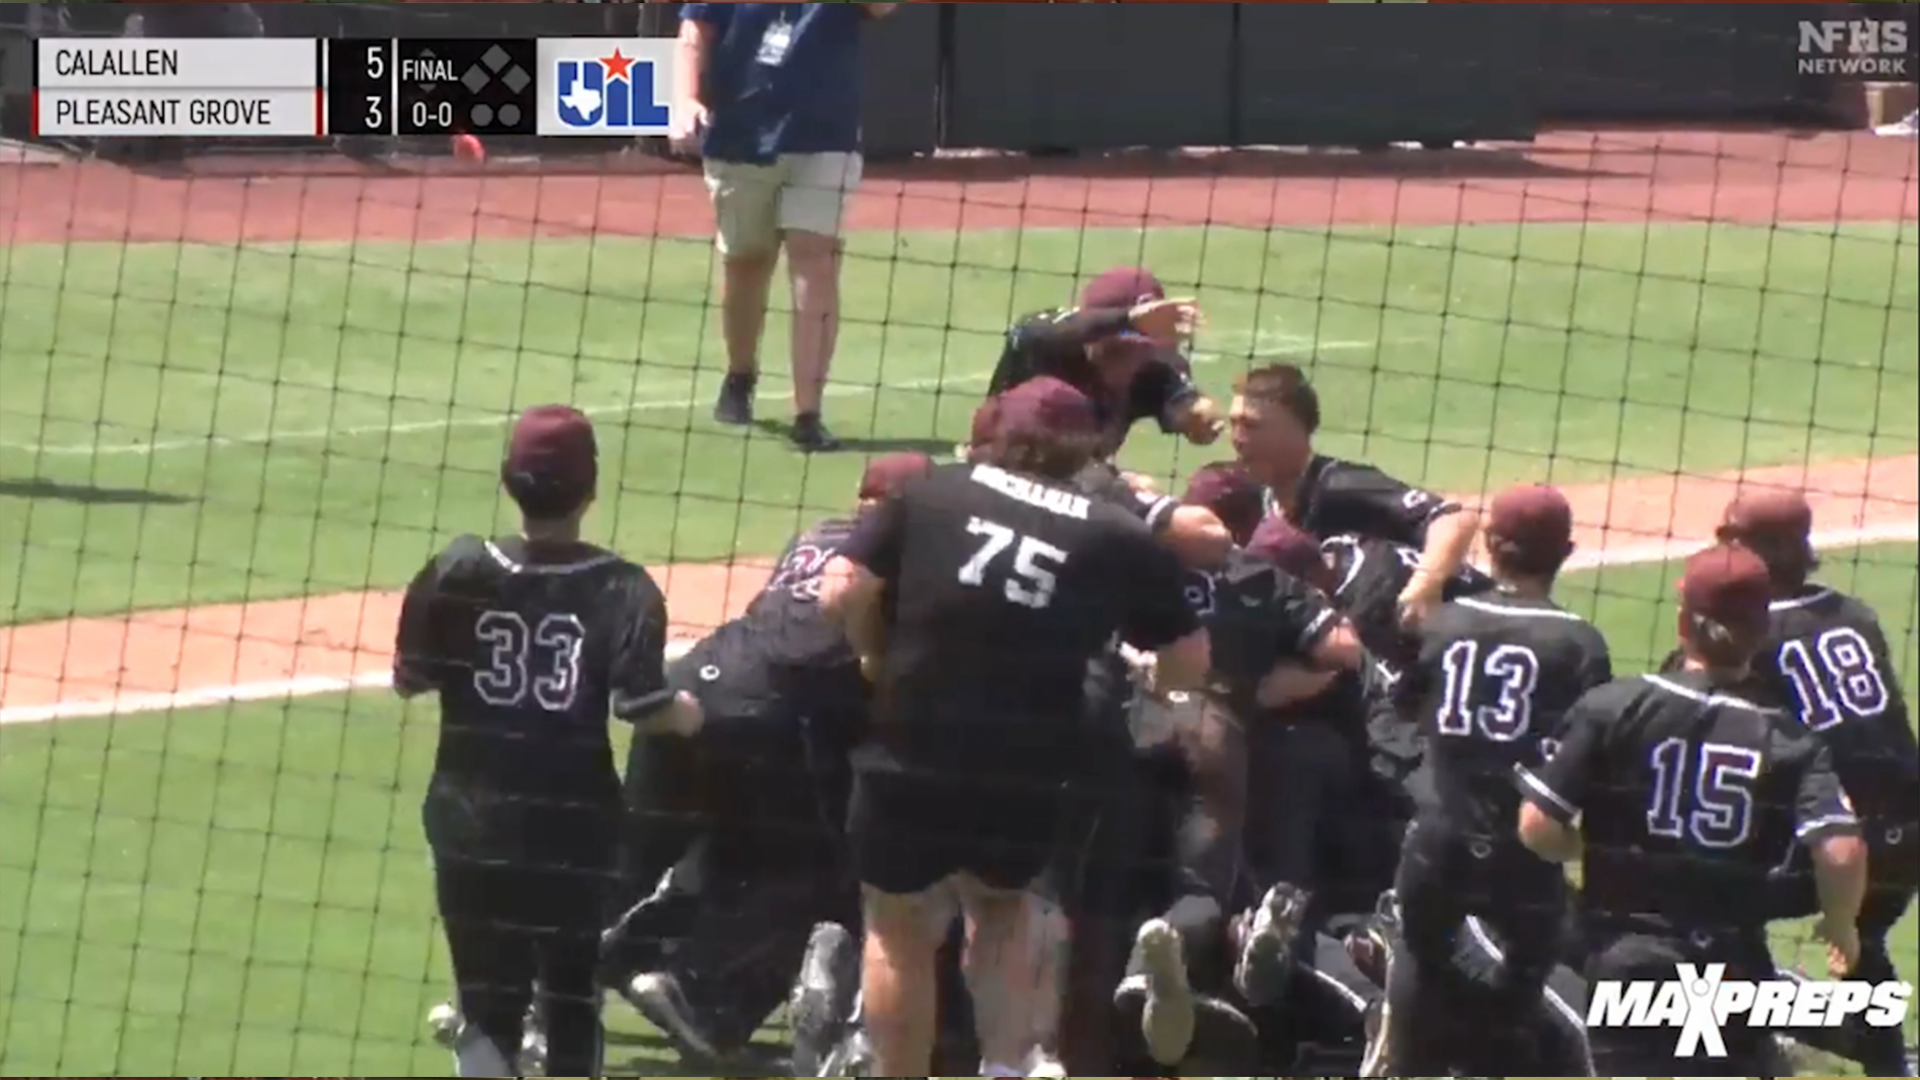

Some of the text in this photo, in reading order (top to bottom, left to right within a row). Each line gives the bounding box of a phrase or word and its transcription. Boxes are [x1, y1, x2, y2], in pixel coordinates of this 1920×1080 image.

[957, 515, 1069, 609] 75
[473, 610, 586, 711] 33
[1437, 639, 1539, 742] 13
[1779, 627, 1889, 731] 18
[1646, 736, 1762, 848] 15
